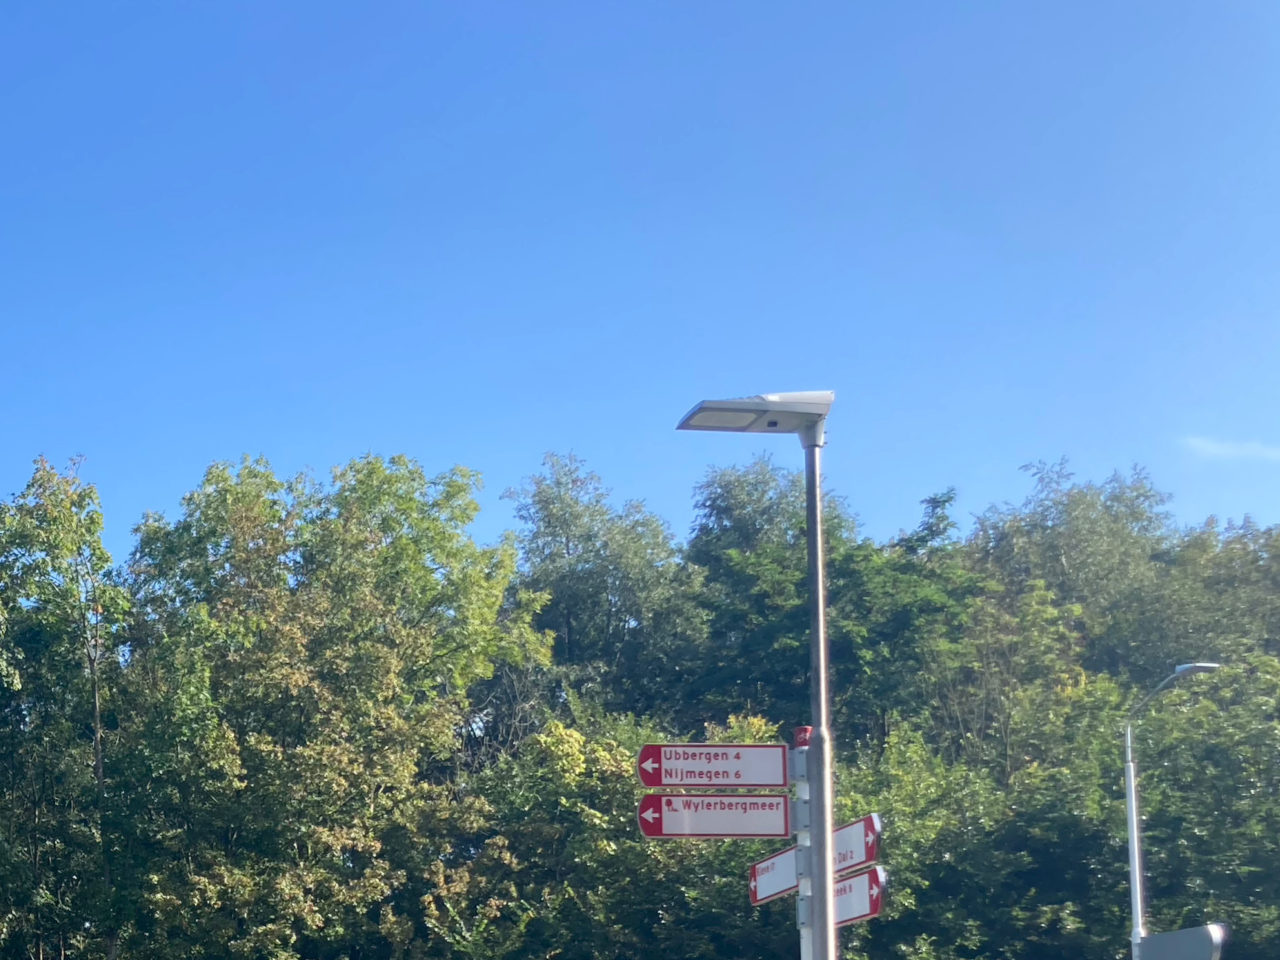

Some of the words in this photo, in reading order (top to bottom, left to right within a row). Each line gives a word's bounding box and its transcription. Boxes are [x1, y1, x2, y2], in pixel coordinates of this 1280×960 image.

[664, 750, 728, 764] Ubbergen
[733, 752, 741, 760] 4
[664, 768, 729, 781] Nijmegen
[734, 770, 741, 779] 6
[682, 799, 781, 813] Wylerbergmeer
